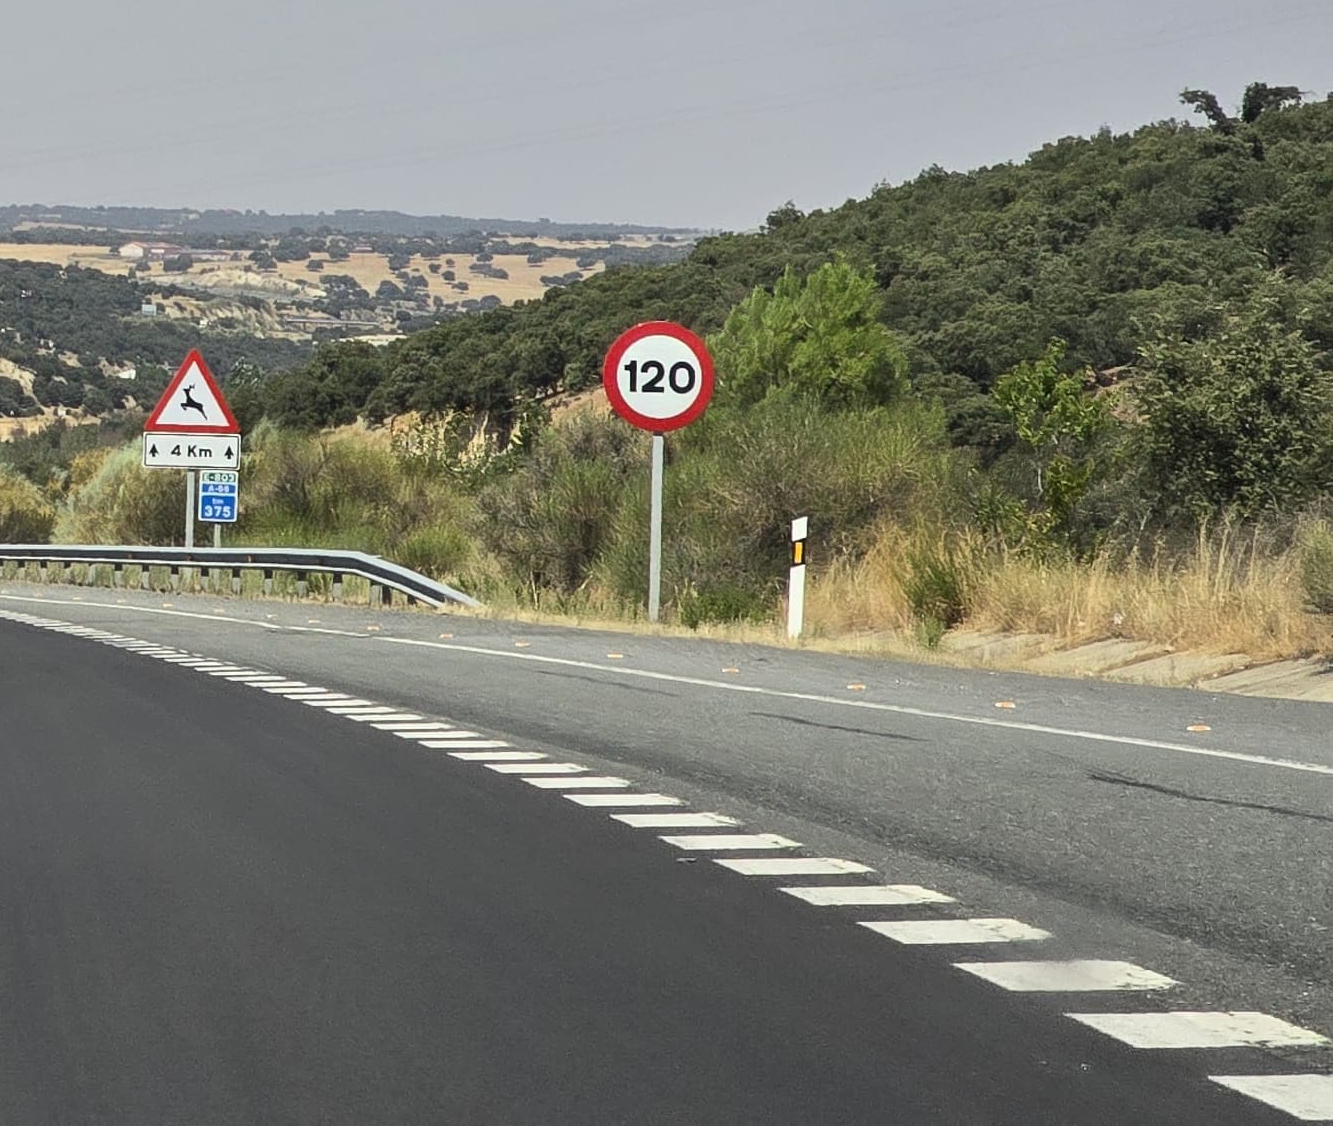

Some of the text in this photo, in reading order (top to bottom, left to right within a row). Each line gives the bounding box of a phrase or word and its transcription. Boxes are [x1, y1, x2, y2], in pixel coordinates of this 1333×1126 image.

[624, 360, 696, 394] 120
[170, 445, 213, 457] 4 Km
[204, 505, 231, 518] 375
